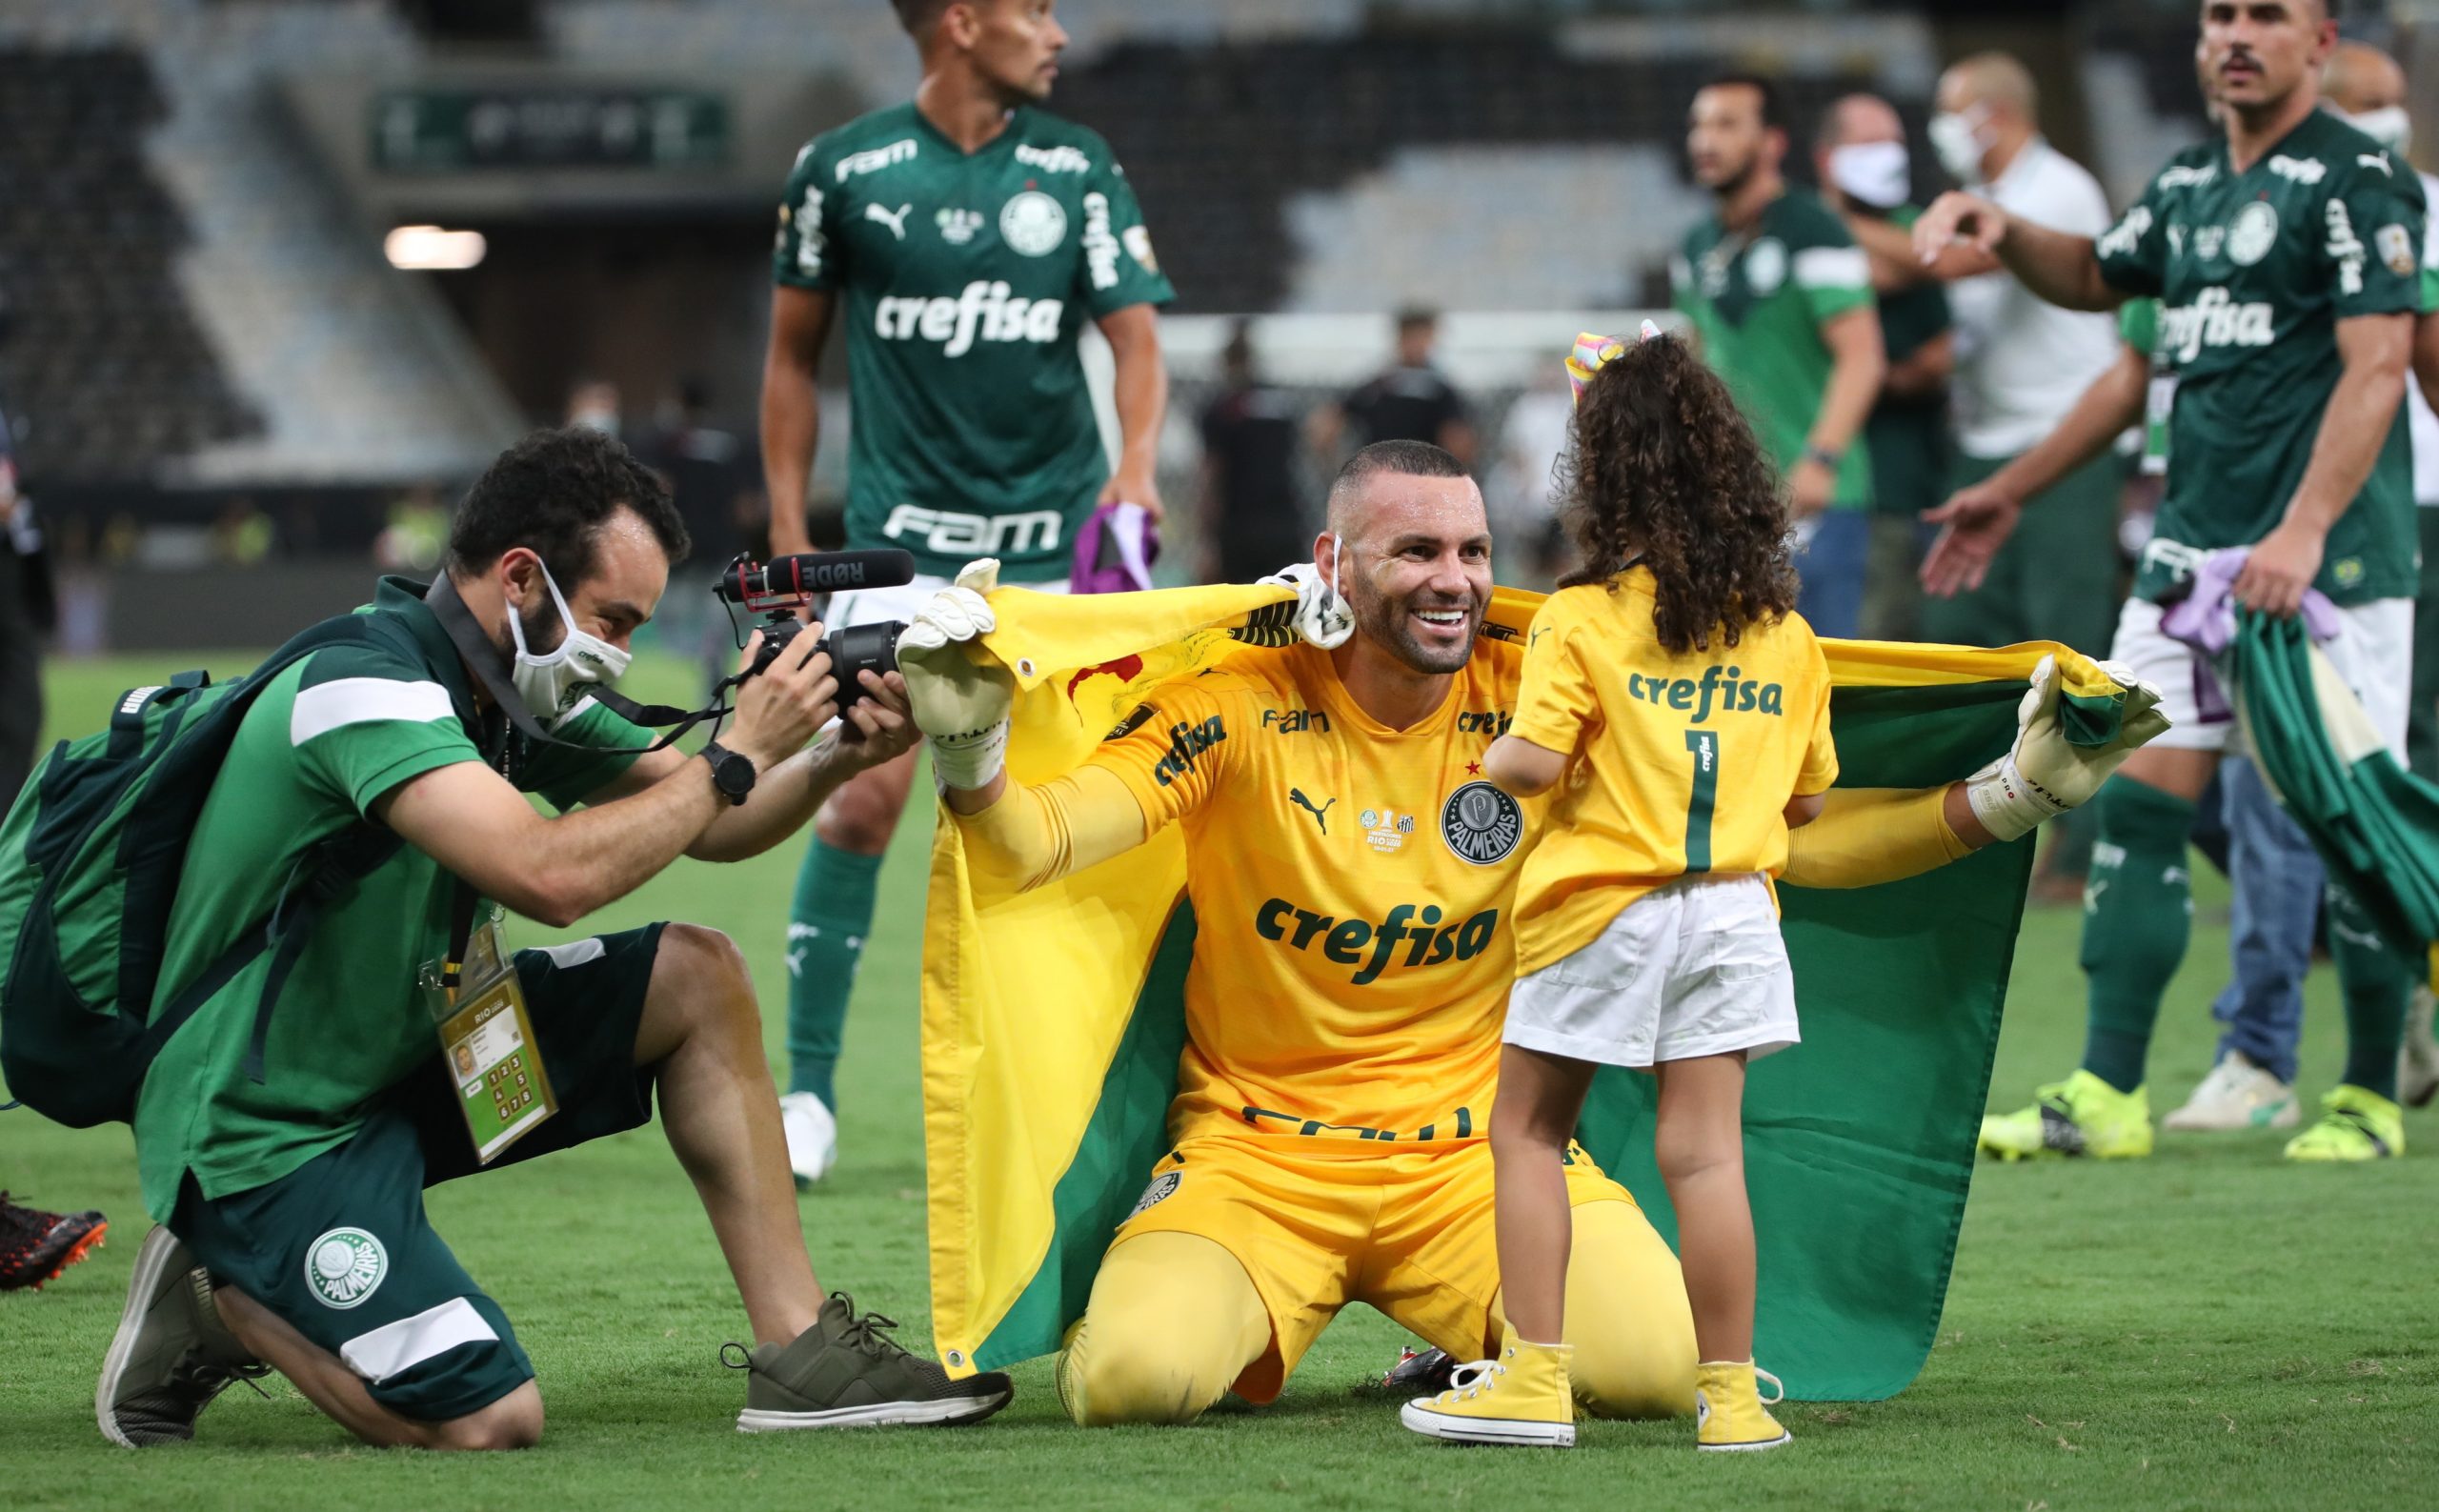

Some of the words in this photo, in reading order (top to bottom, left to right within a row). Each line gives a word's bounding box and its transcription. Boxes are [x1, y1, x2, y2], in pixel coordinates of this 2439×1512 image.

[875, 279, 1064, 358] crefisa
[802, 562, 865, 588] RØDE
[1629, 665, 1784, 723] crefisa
[1154, 715, 1228, 787] crefisa
[1684, 730, 1718, 873] 1
[2002, 777, 2015, 798] PRO
[1447, 814, 1517, 859] PALMEIRAS
[1255, 897, 1499, 985] crefisa
[322, 1241, 379, 1301] PALMEIRAS
